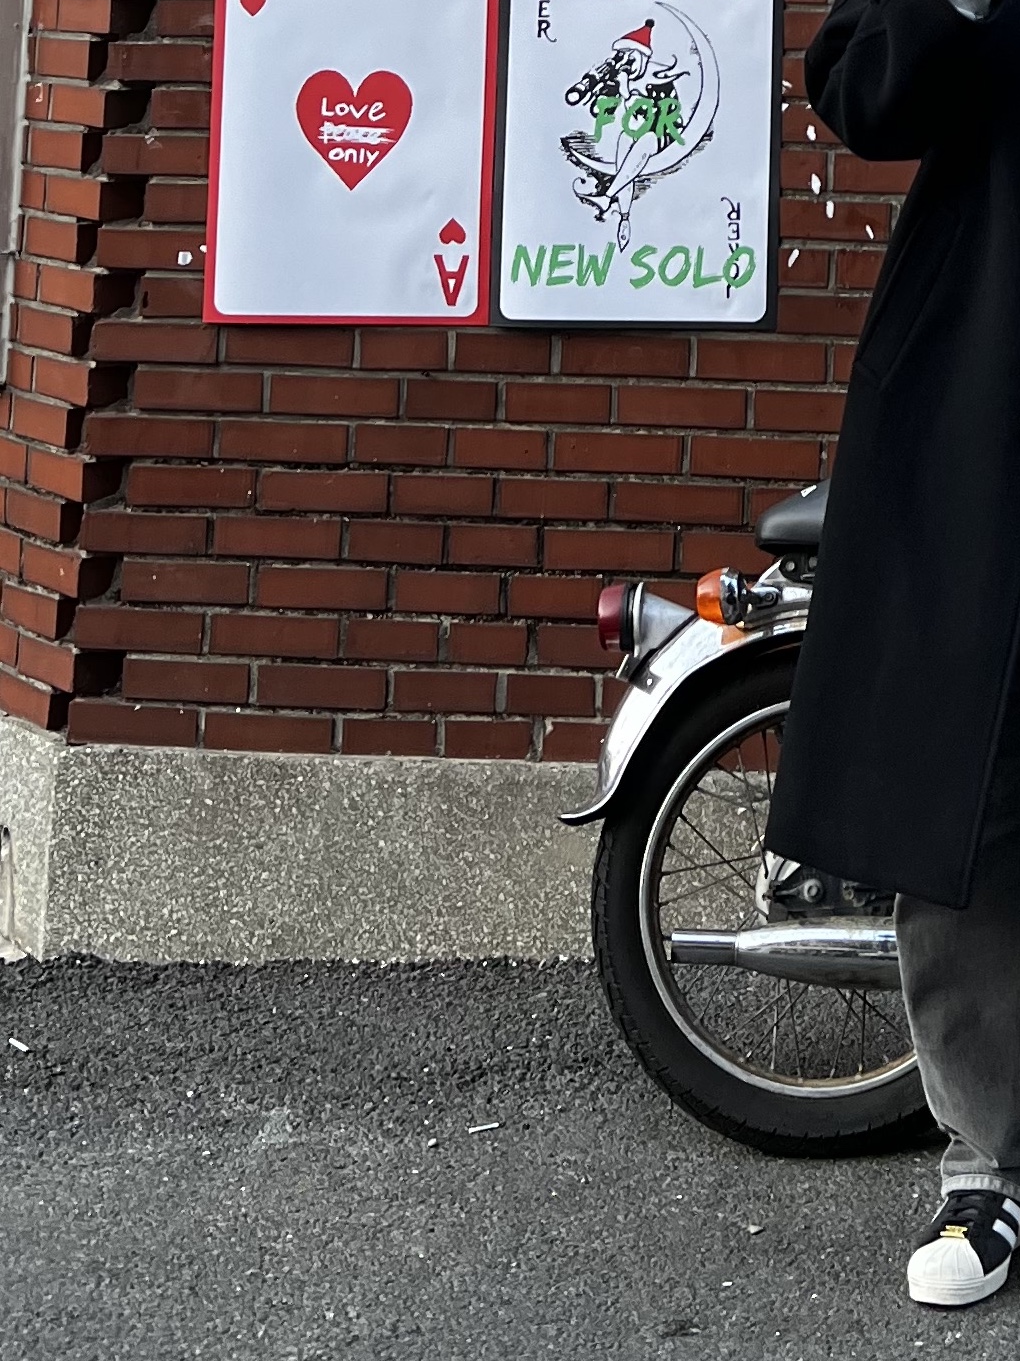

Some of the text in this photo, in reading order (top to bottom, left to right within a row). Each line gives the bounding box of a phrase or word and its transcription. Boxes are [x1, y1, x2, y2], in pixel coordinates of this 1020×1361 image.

[321, 96, 387, 122] Love
[593, 95, 686, 147] FOR
[327, 147, 380, 168] only
[433, 254, 470, 307] A
[510, 241, 757, 290] NEW SOLO
